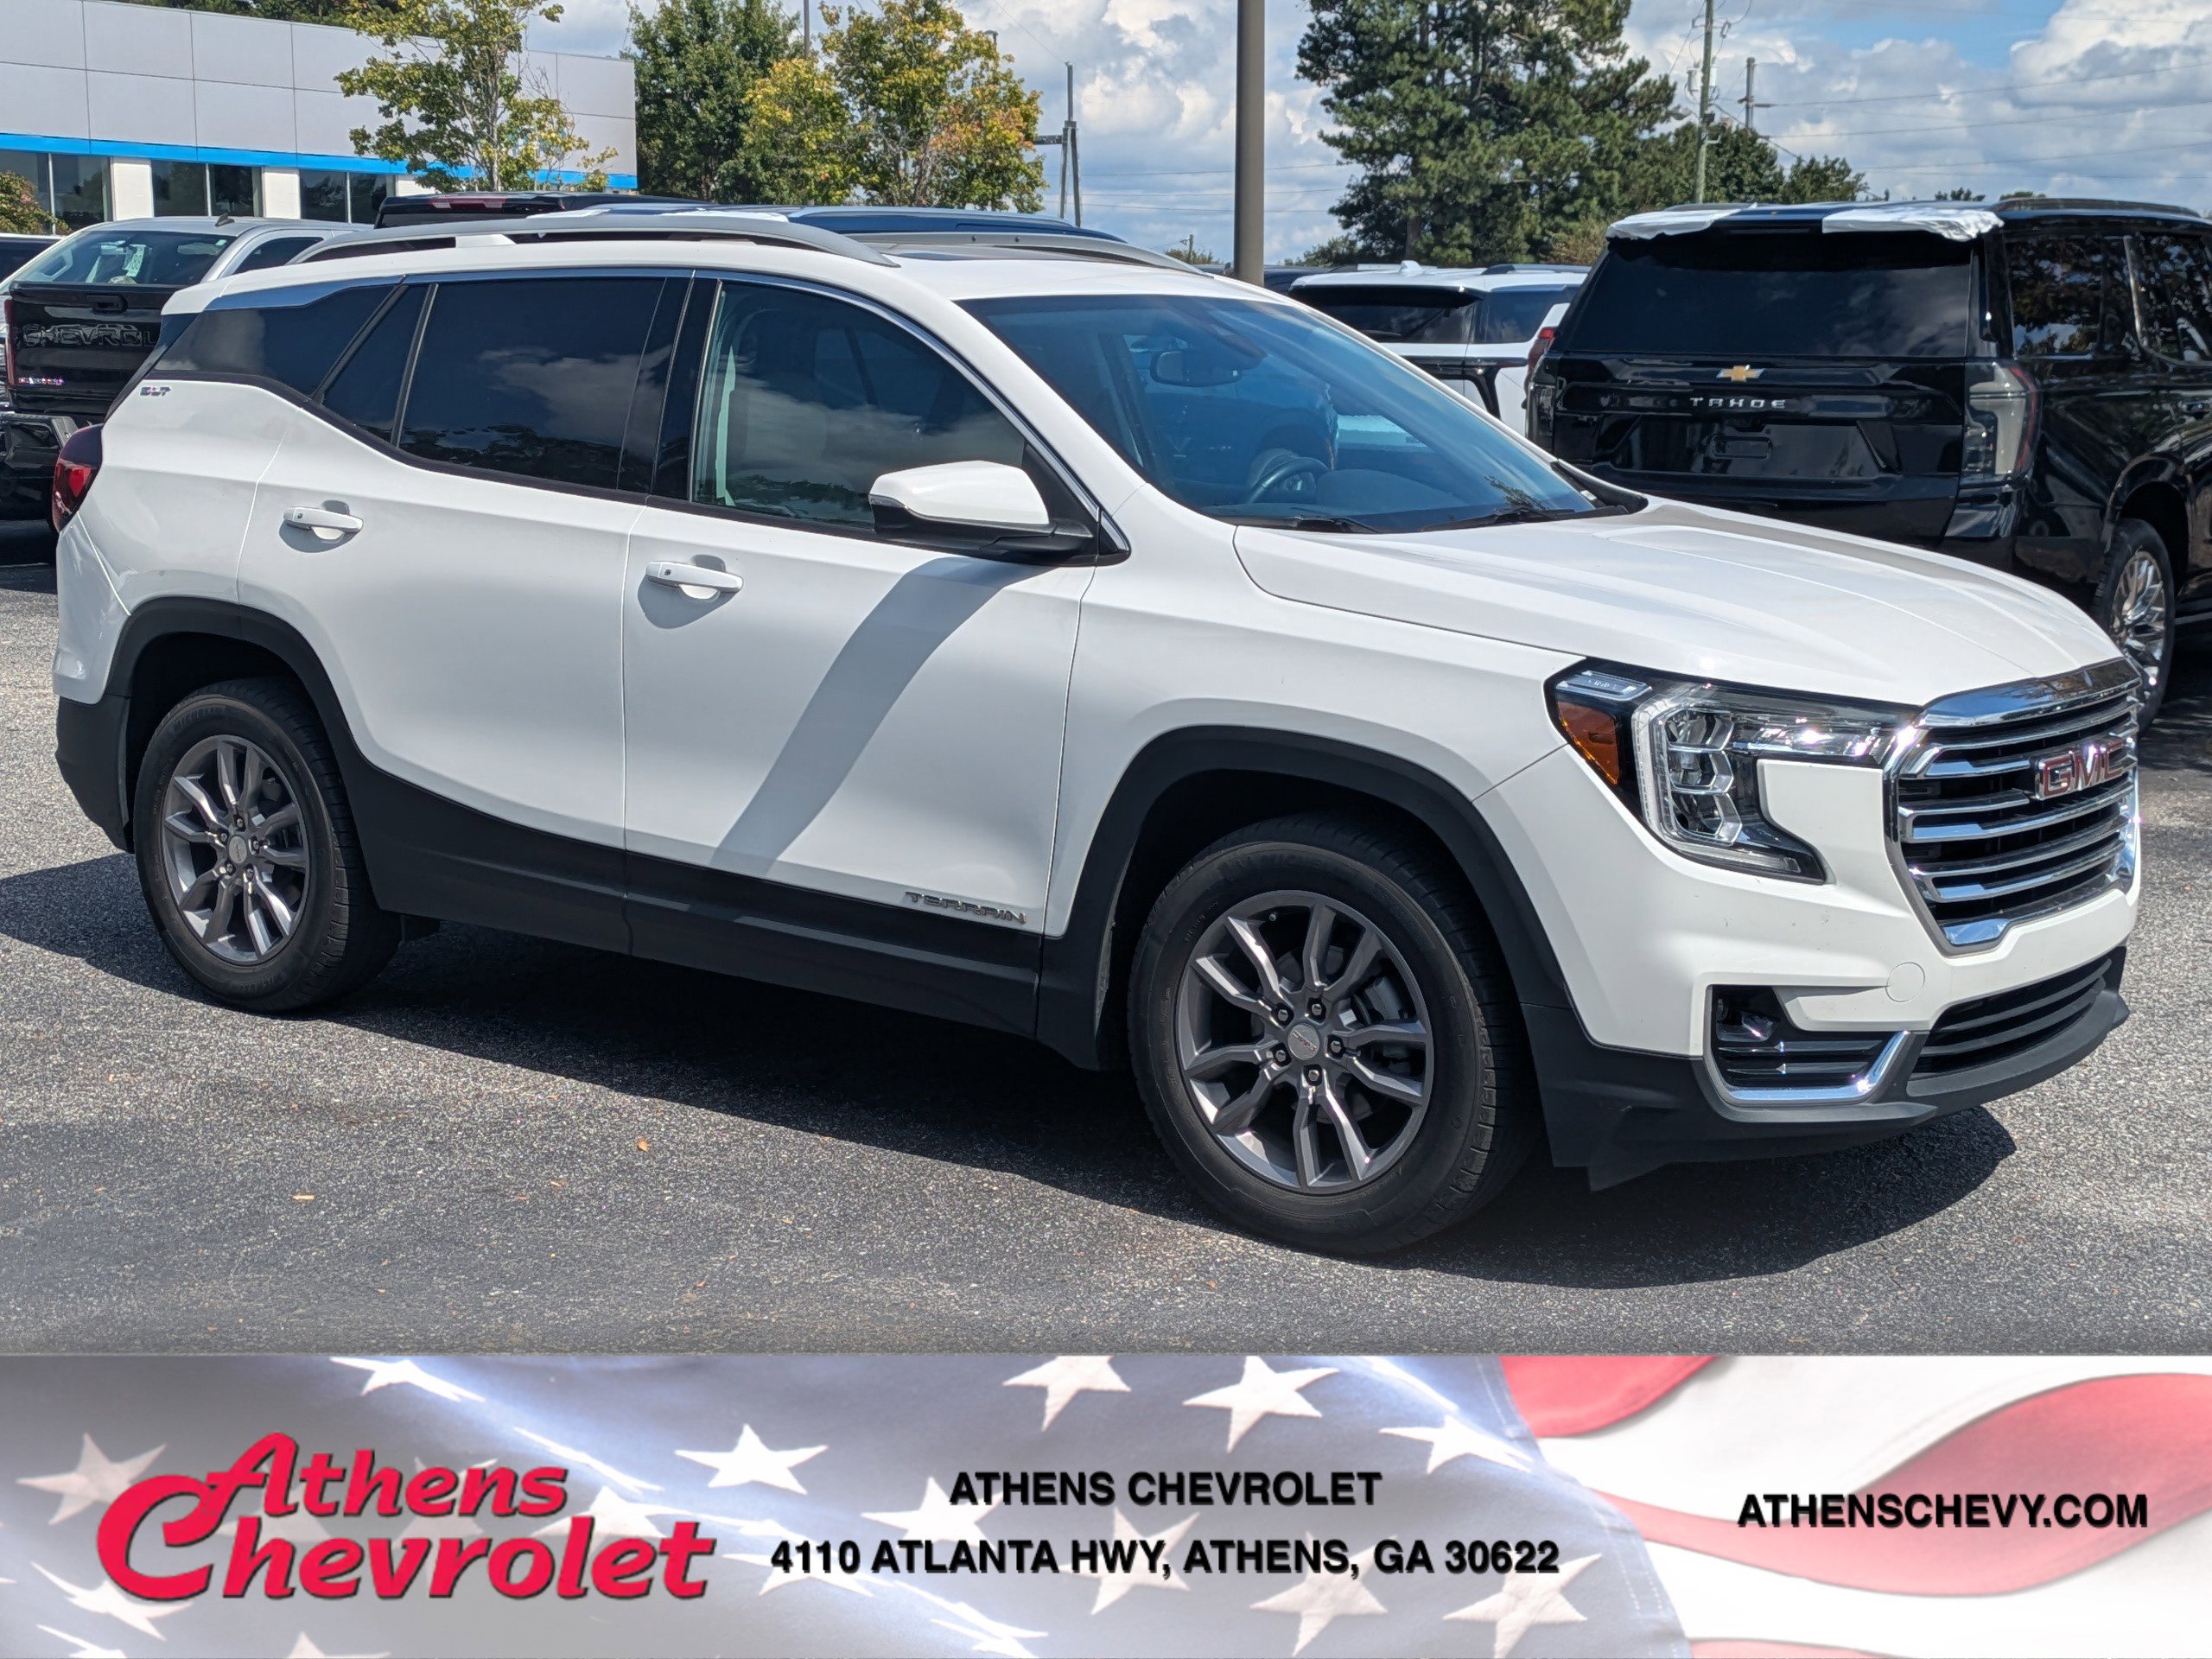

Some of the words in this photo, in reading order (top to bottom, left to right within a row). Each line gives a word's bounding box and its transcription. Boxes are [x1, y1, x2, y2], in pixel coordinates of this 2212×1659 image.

[22, 323, 157, 346] CHEVROL
[1690, 397, 1786, 409] TAHOE
[2039, 738, 2128, 798] GMC
[906, 892, 1027, 925] TERRAIN
